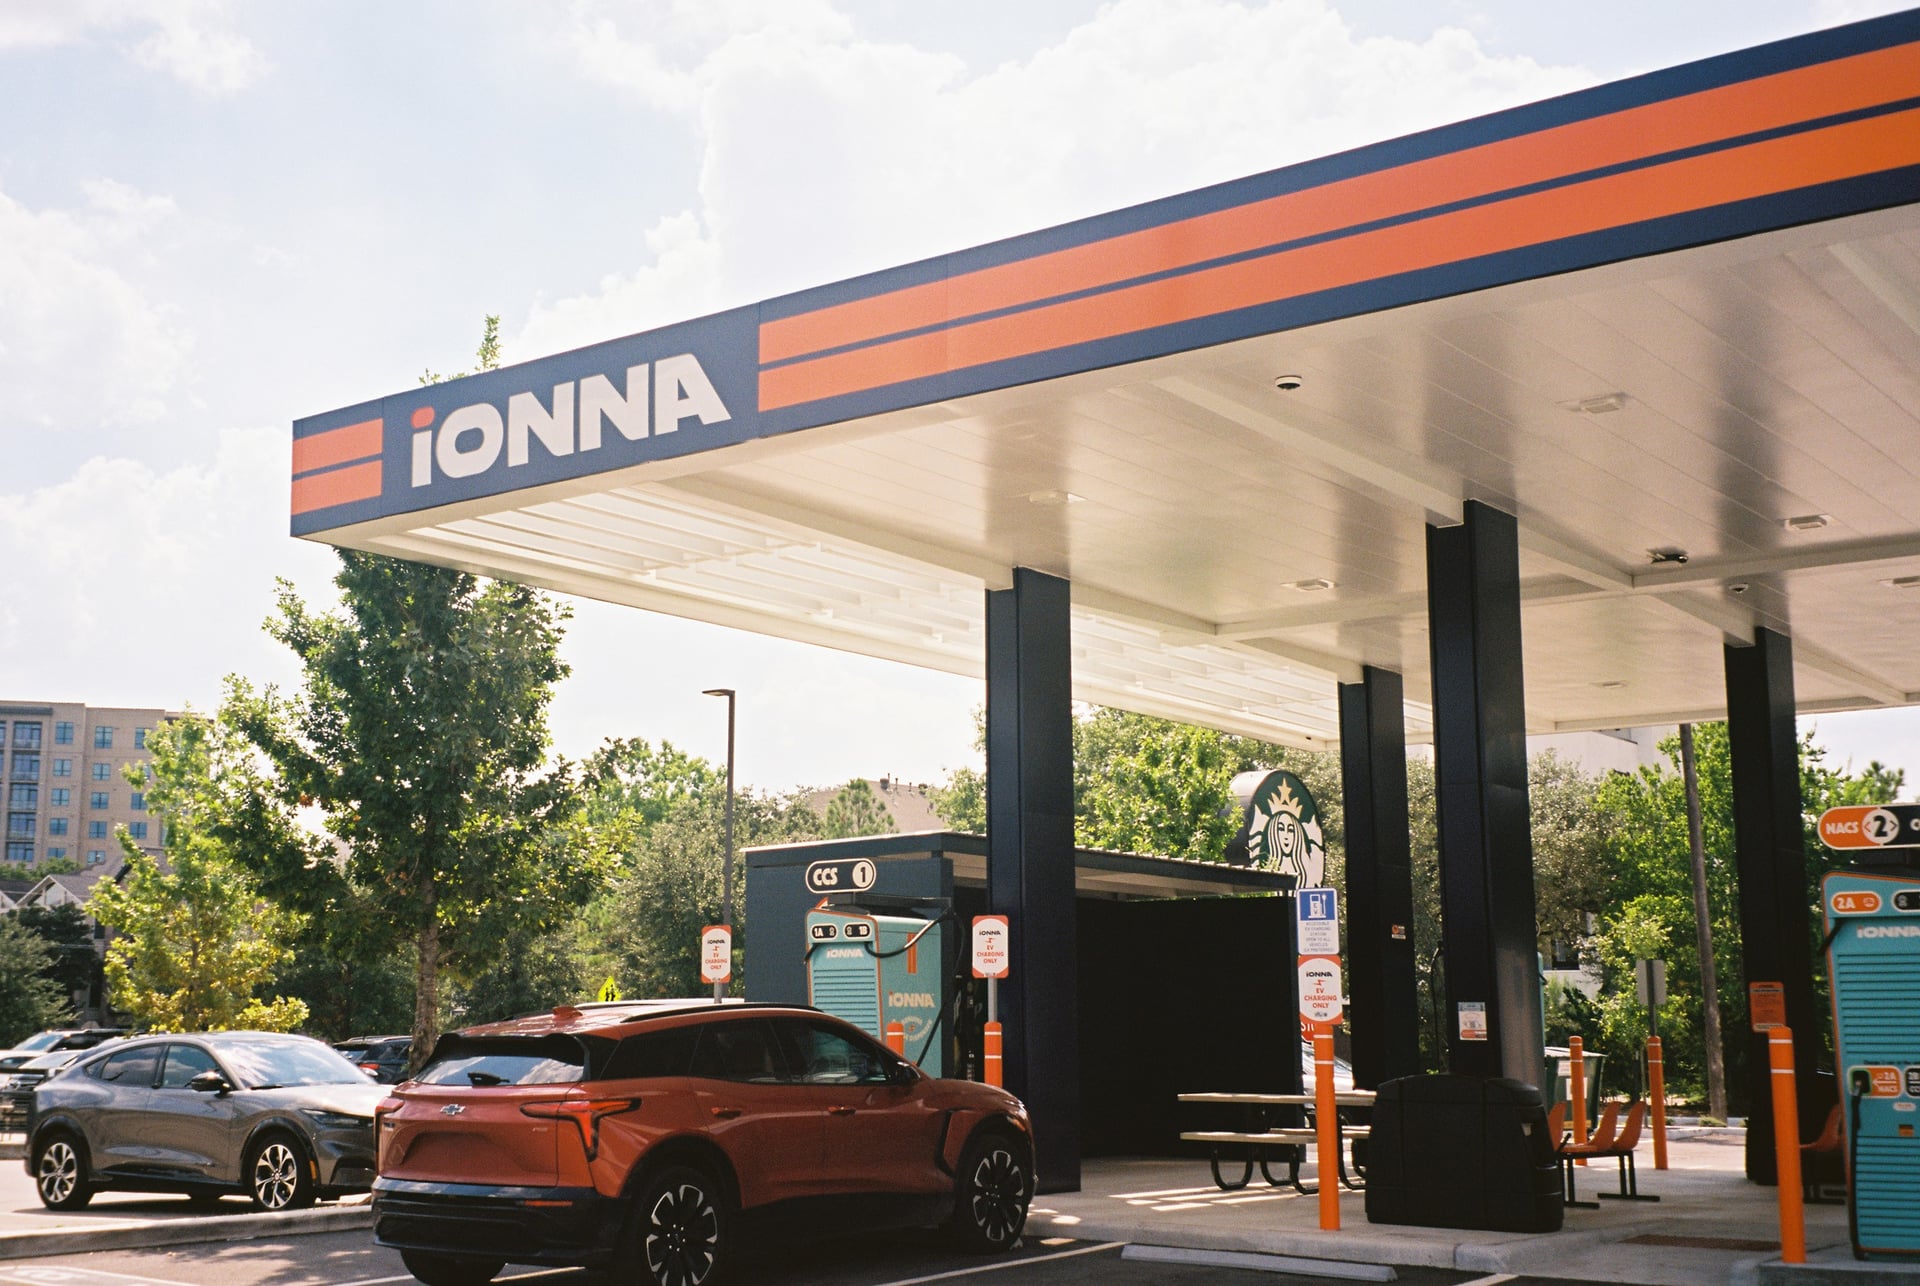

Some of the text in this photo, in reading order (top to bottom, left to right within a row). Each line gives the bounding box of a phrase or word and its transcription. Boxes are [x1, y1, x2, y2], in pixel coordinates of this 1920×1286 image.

[410, 353, 732, 488] iONNA
[1826, 815, 1888, 837] NACS 2
[813, 866, 866, 886] CCS 1
[1837, 898, 1856, 909] 2A
[814, 927, 823, 937] 1A
[859, 925, 868, 935] 1B
[888, 991, 936, 1008] iONNA
